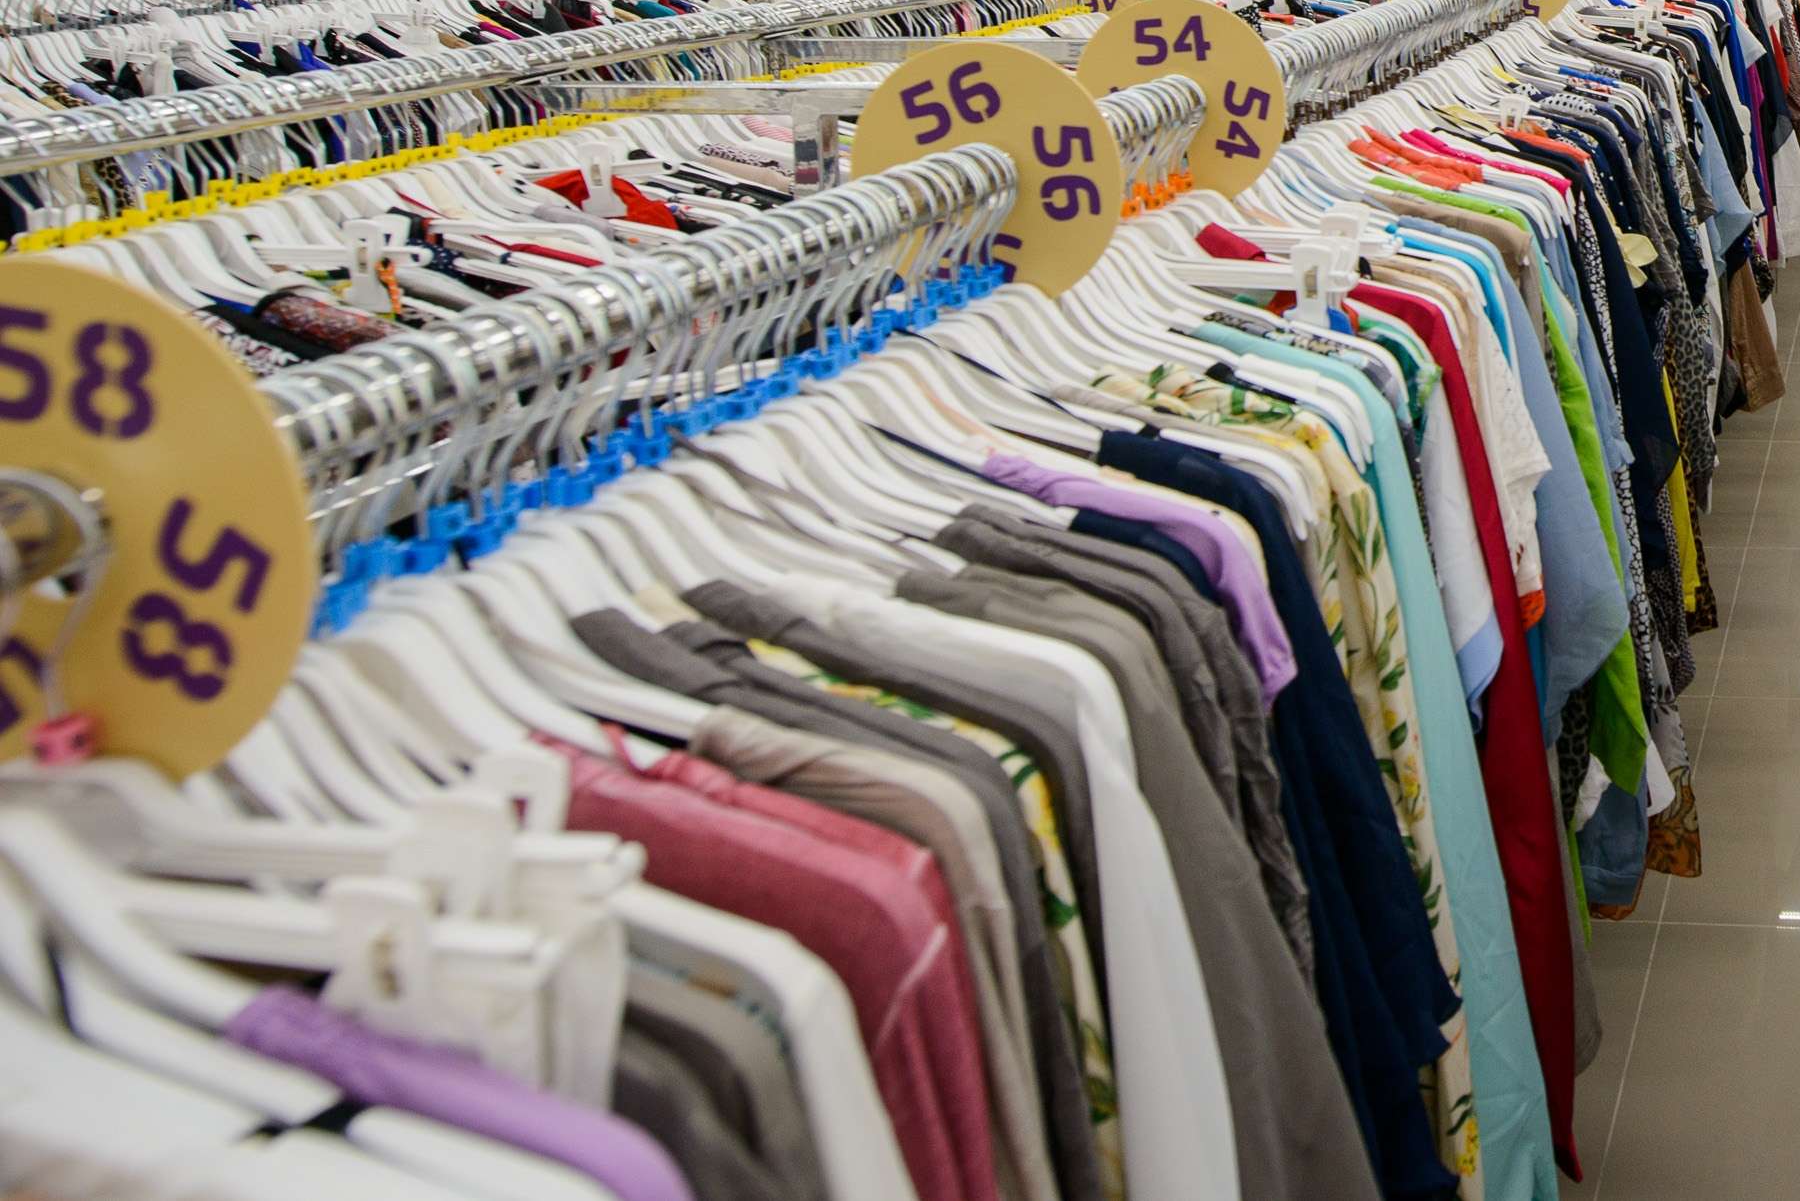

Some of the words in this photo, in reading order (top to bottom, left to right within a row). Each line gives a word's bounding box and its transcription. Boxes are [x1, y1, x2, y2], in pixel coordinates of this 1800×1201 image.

[1133, 14, 1212, 66] 54
[899, 61, 1001, 145] 56
[1215, 79, 1271, 159] 54
[1032, 125, 1101, 222] 56
[0, 305, 154, 439] 58
[122, 498, 272, 702] 58
